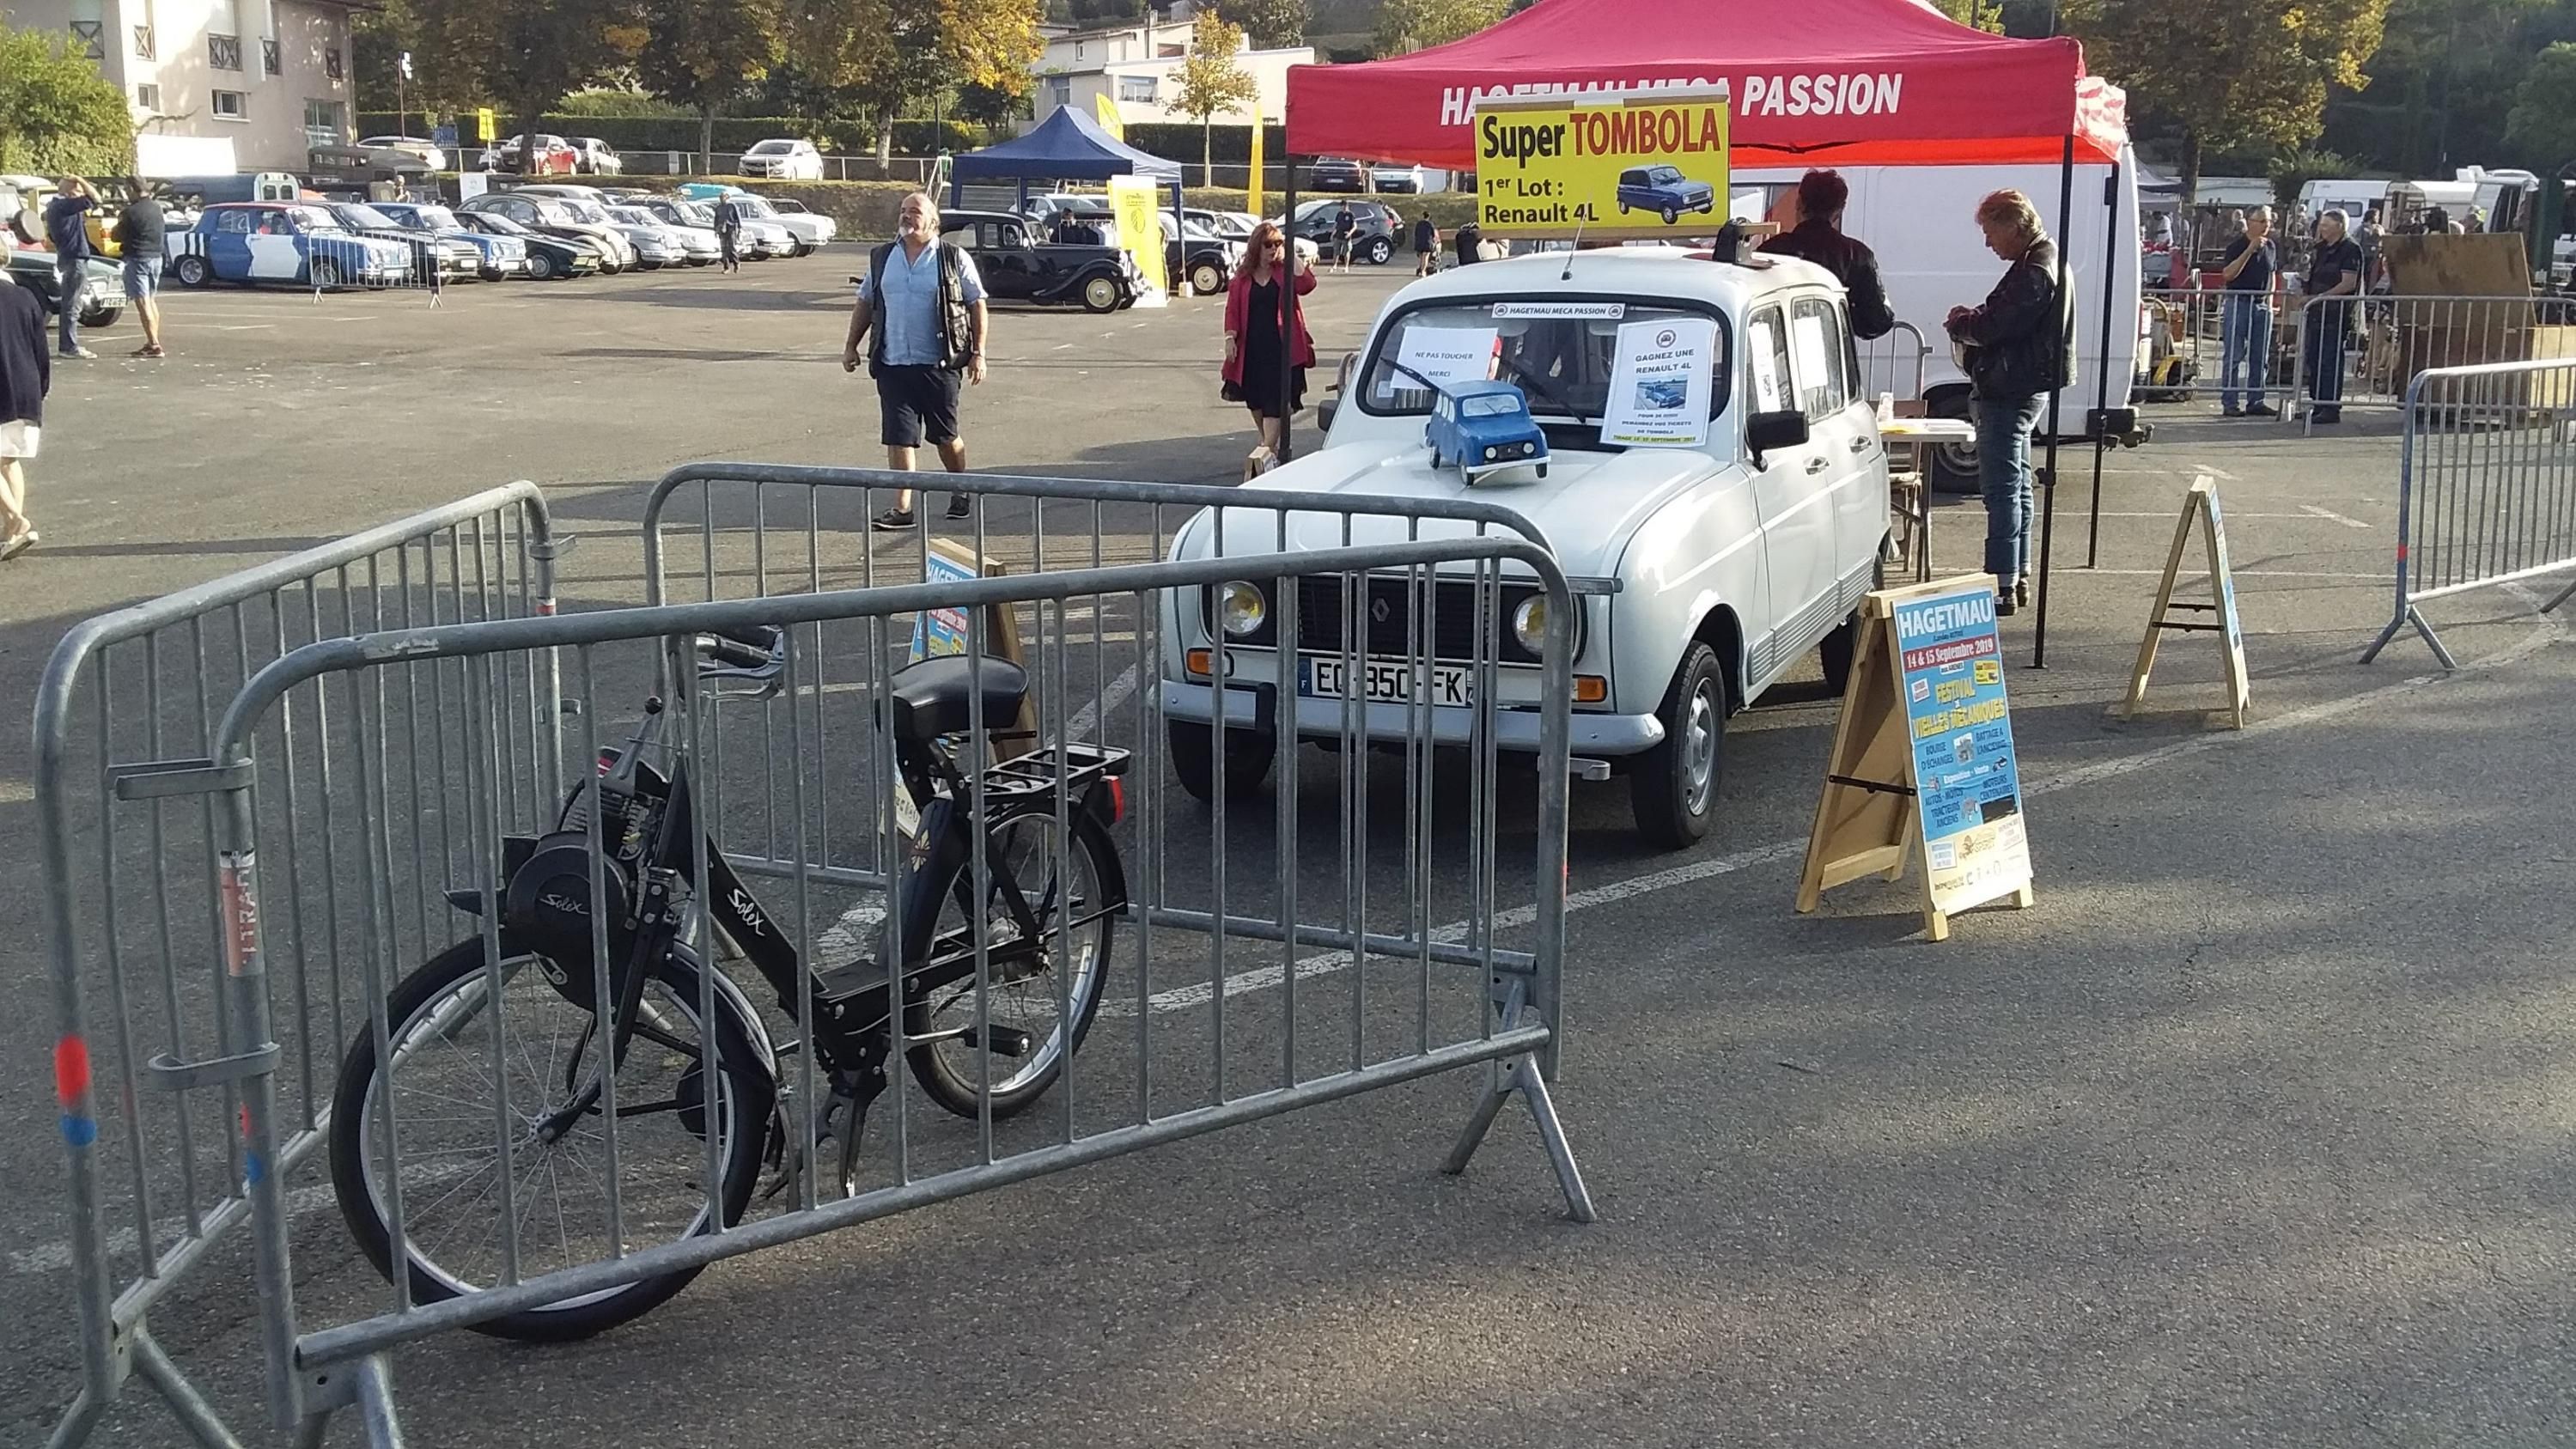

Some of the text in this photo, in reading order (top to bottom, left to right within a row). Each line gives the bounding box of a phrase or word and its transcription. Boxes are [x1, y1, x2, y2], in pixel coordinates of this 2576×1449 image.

[1741, 73, 1903, 115] PASSION
[1483, 108, 1720, 168] Super TOMBOLA
[1485, 177, 1511, 198] 1er
[1518, 179, 1552, 198] Lot
[1484, 203, 1599, 223] Renault 4L
[1509, 307, 1606, 315] HAGETMAU MECA PASSION
[1635, 349, 1695, 362] GAGNEZ UNE
[1635, 363, 1678, 374] RENAULT
[1898, 598, 1993, 638] HAGETMAU
[1906, 637, 1994, 668] 14 & 15 Septembre 2019
[1935, 677, 1976, 705] FESTIVAL
[1912, 710, 1950, 739] VIEILLES
